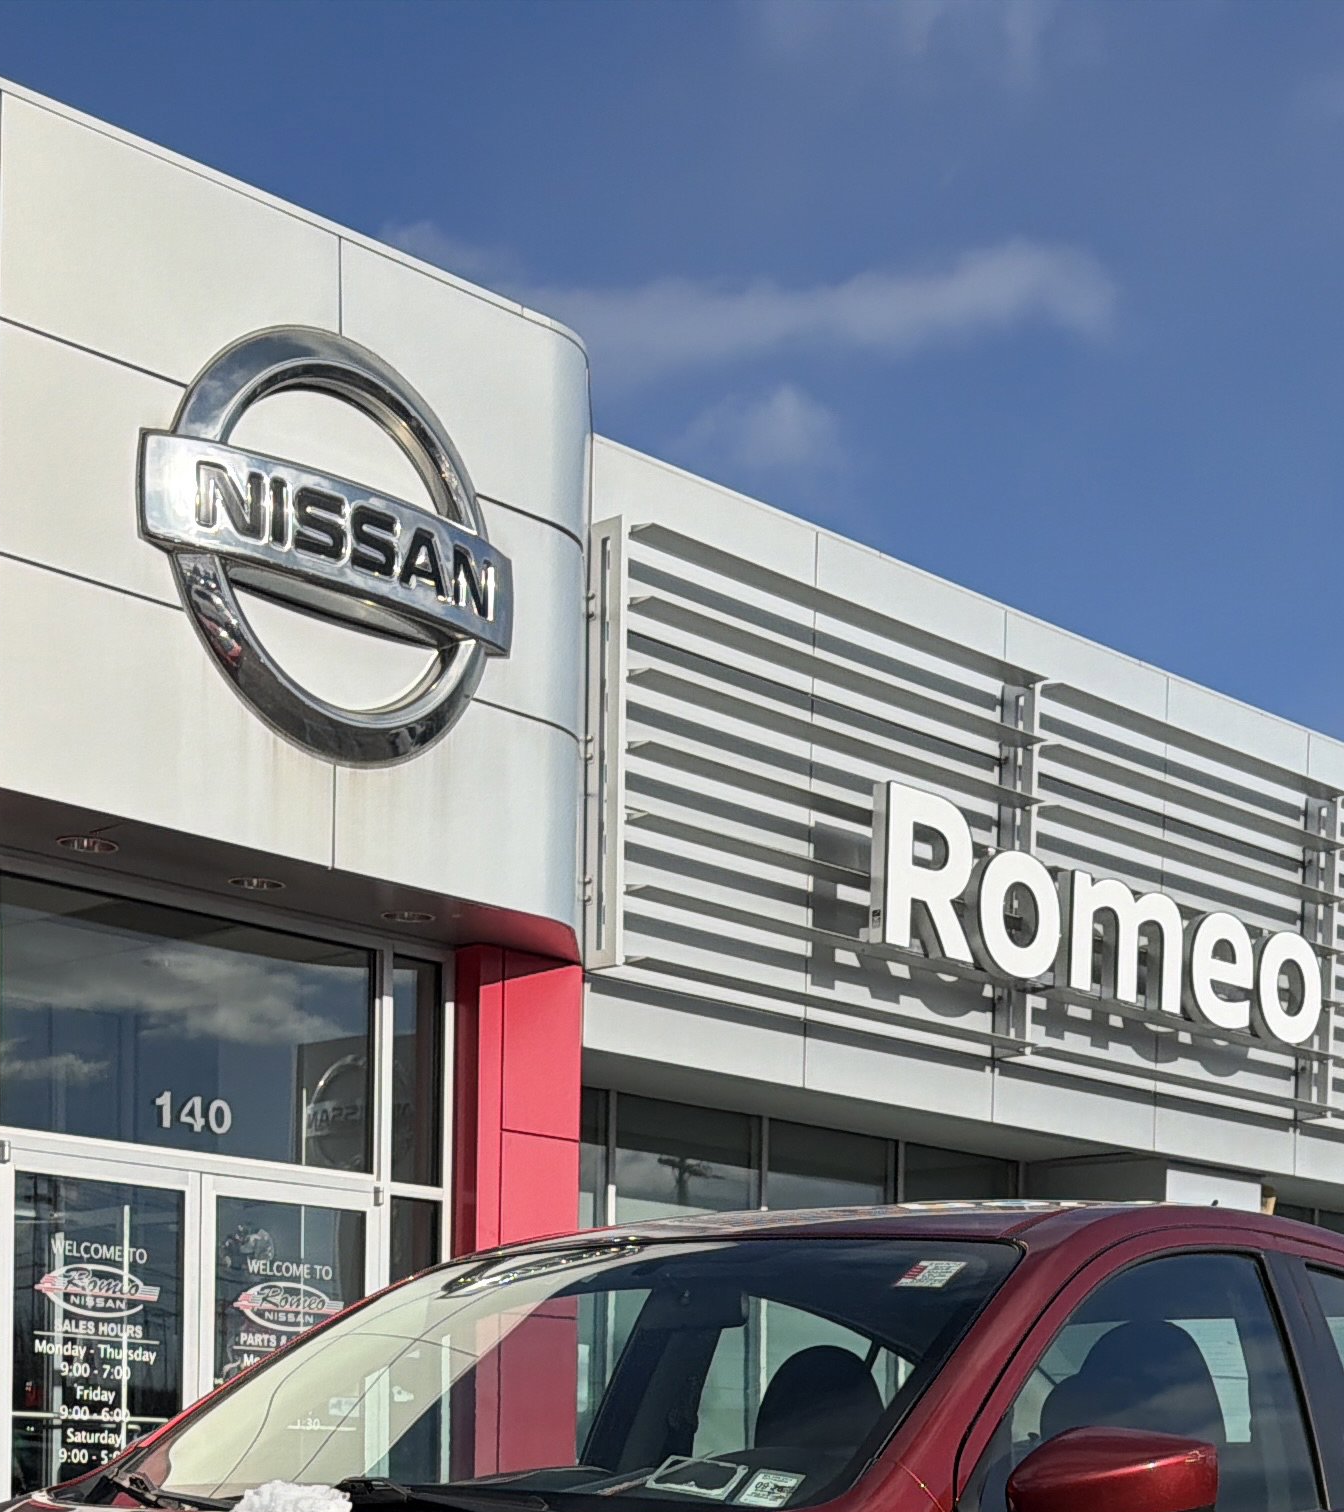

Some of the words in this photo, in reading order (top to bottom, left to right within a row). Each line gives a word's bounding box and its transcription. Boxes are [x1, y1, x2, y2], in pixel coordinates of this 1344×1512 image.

[194, 459, 496, 622] NISSAN
[872, 780, 1322, 1045] Romeo
[155, 1090, 232, 1134] 140
[50, 1238, 124, 1262] WELCOME
[127, 1248, 148, 1264] TO
[247, 1257, 311, 1279] WELCOME
[314, 1264, 333, 1280] TO
[70, 1294, 127, 1310] NISSAN
[258, 1285, 326, 1310] Romeo
[264, 1311, 314, 1324] NISSAN
[54, 1319, 96, 1334] SALES
[98, 1322, 143, 1339] HOURS
[240, 1332, 277, 1347] PARTS
[34, 1339, 87, 1359] Monday
[97, 1344, 157, 1365] Thusday
[60, 1361, 91, 1378] 9:00
[102, 1364, 131, 1380] 7:00
[75, 1385, 116, 1405] Friday
[59, 1405, 90, 1420] 9:00
[101, 1407, 131, 1422] 6:00
[66, 1428, 123, 1447] Saturday
[58, 1448, 89, 1464] 9:00
